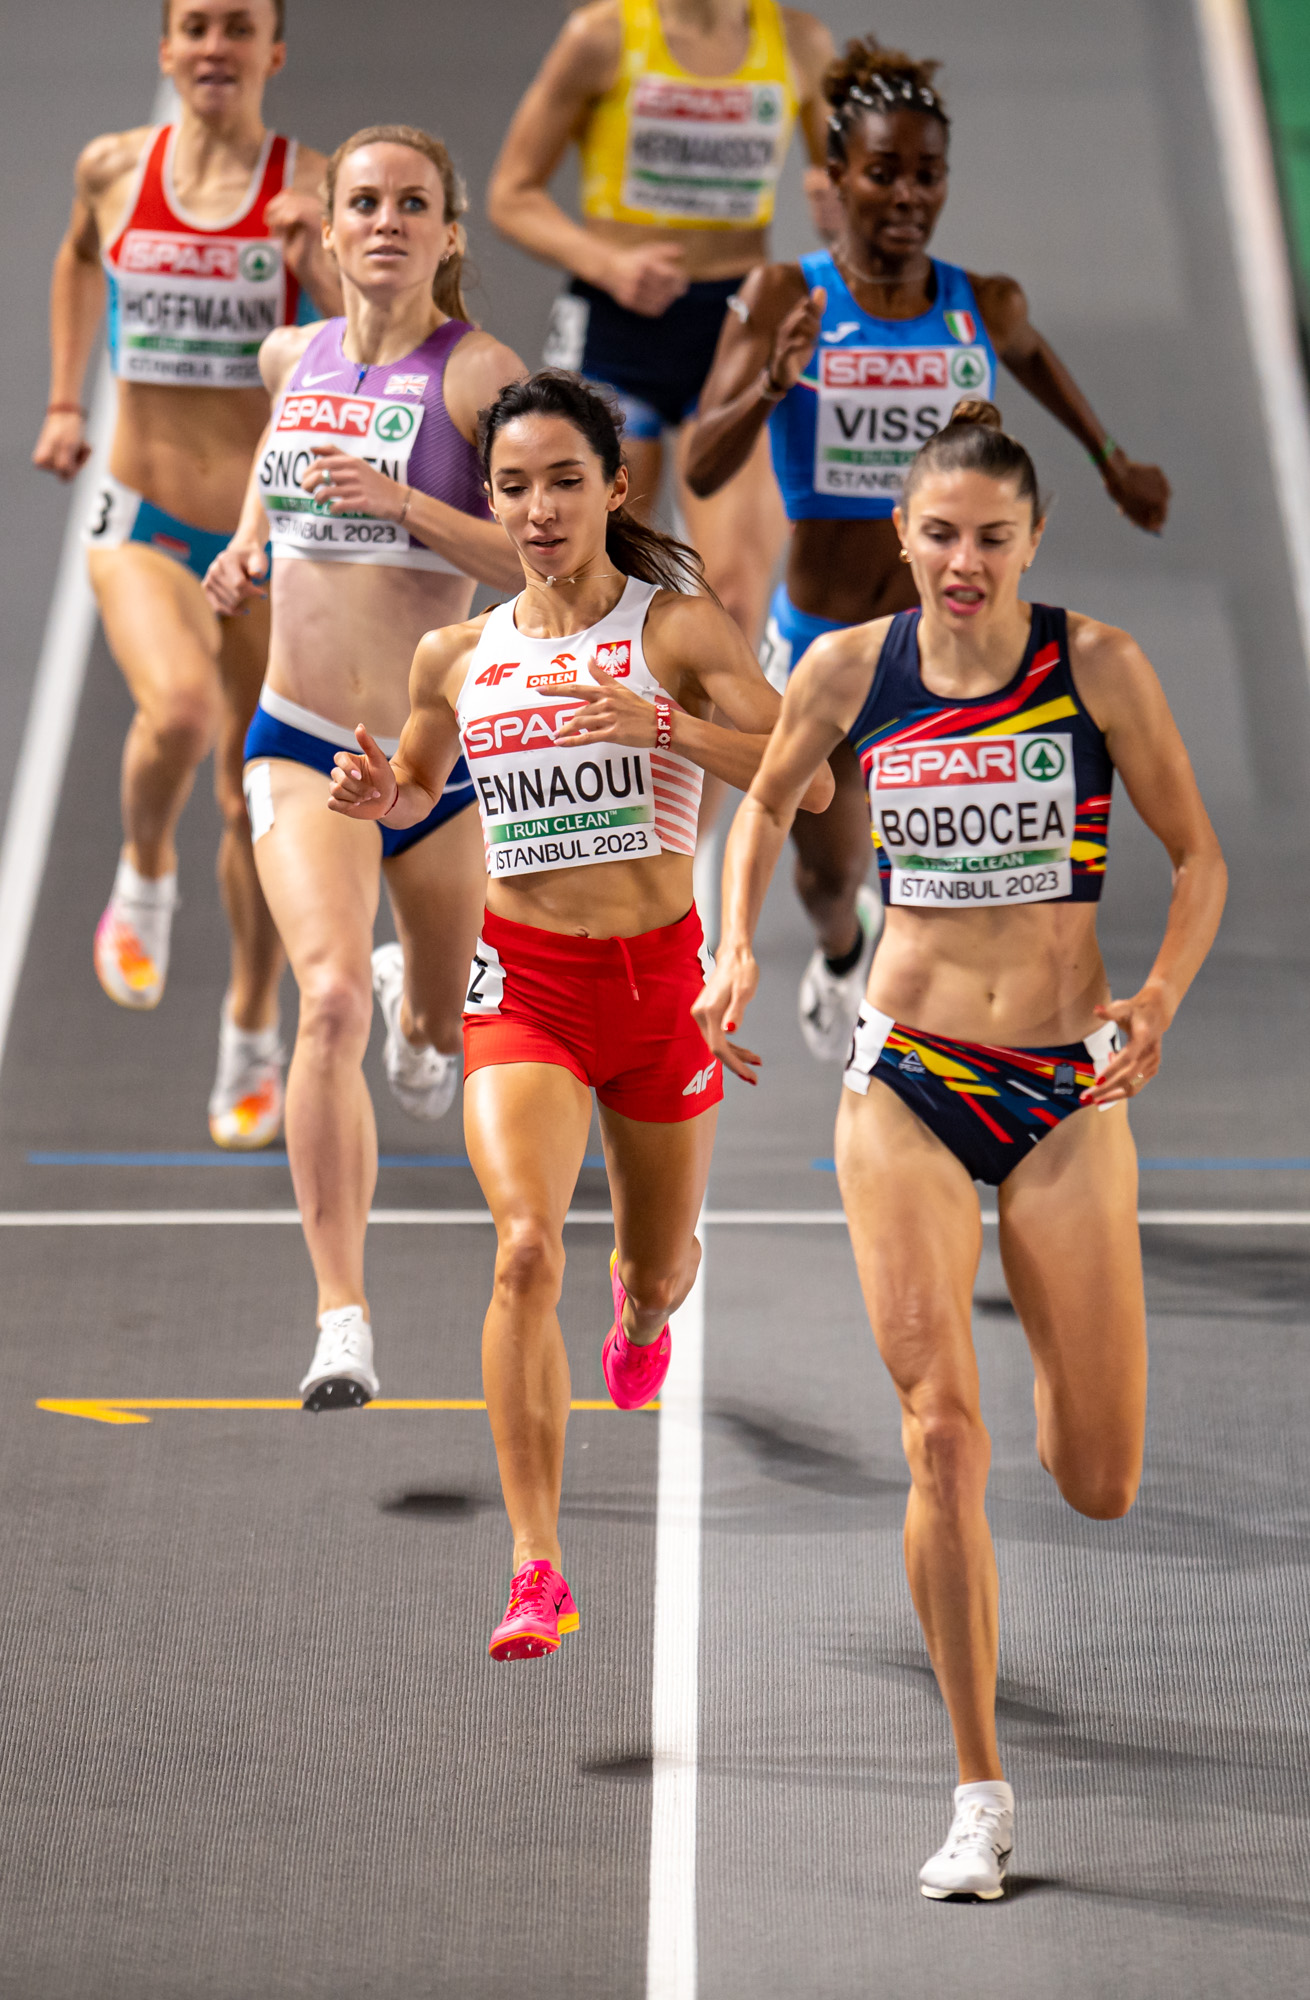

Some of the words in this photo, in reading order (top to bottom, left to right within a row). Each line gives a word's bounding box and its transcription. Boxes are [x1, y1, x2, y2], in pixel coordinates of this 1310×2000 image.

[130, 241, 232, 276] SPAR
[124, 291, 278, 330] HOFFMANN
[827, 355, 944, 385] SPAR
[279, 397, 371, 433] SPAR
[344, 523, 397, 544] 2023
[529, 672, 575, 687] ORLEN
[879, 745, 1014, 784] SPAR
[477, 755, 645, 817] ENNAOUI
[505, 826, 511, 839] I
[514, 819, 550, 838] RUN
[880, 800, 1067, 848] BOBOCEA
[496, 839, 590, 871] ISTANBUL
[593, 830, 649, 856] 2023
[901, 877, 1001, 900] ISTANBUL
[1006, 870, 1060, 897] 2023
